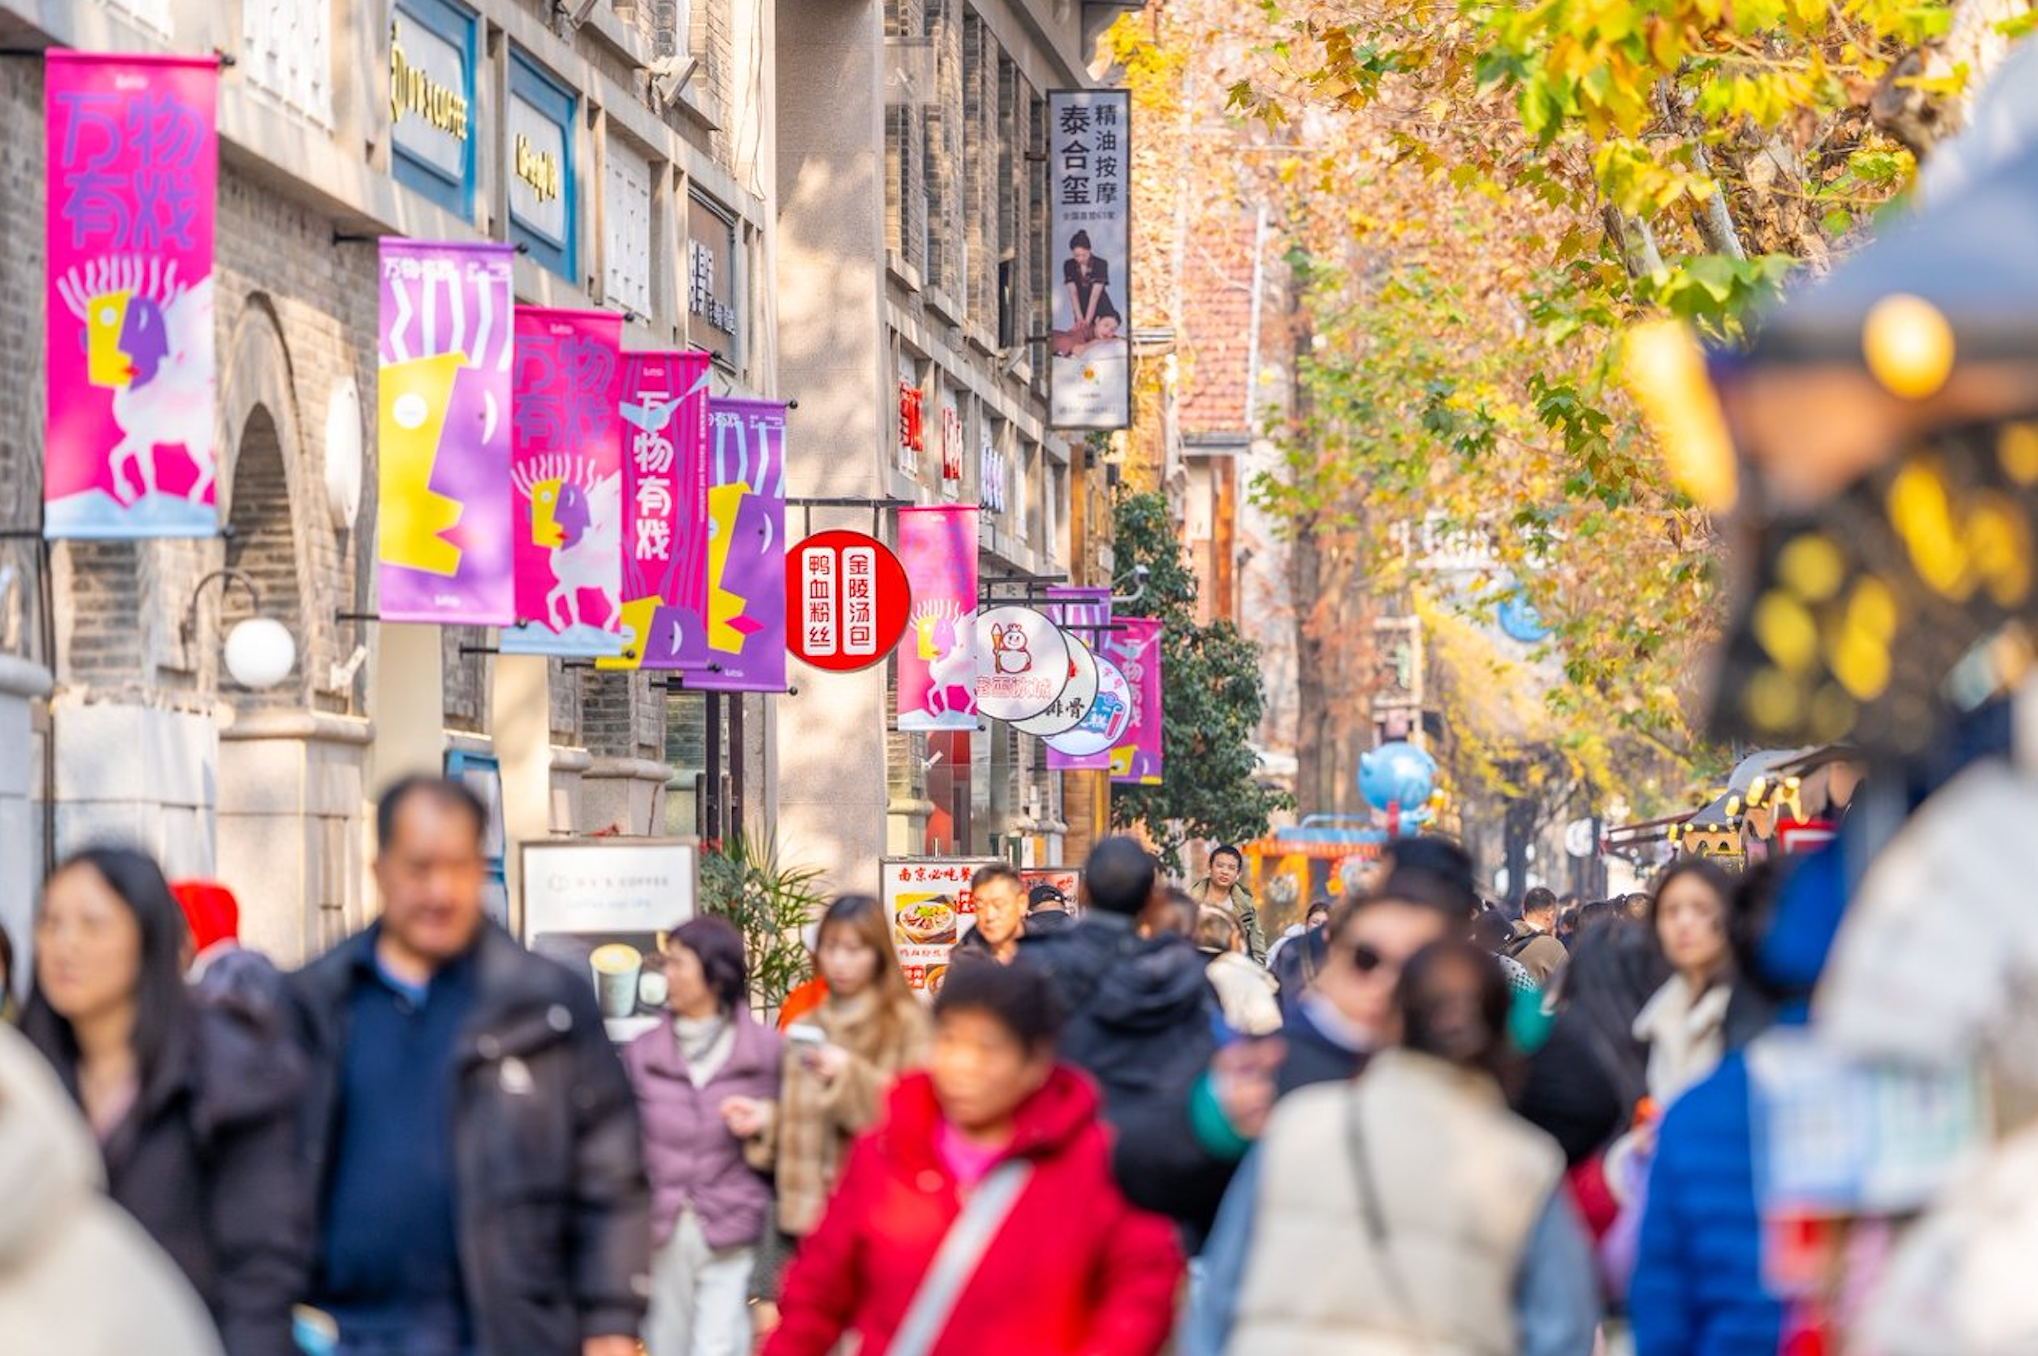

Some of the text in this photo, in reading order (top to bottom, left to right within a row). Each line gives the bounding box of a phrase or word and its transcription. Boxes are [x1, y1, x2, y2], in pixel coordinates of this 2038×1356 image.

[57, 92, 206, 169] 万物
[1060, 105, 1090, 205] 泰合玺
[1095, 104, 1117, 204] 精油按摩
[63, 170, 196, 248] 有戏
[515, 335, 614, 392] 万物
[515, 393, 610, 449] 有戏
[633, 391, 674, 561] 万物有戏
[809, 555, 831, 647] 鸭血粉丝
[849, 555, 870, 646] 金陵汤包
